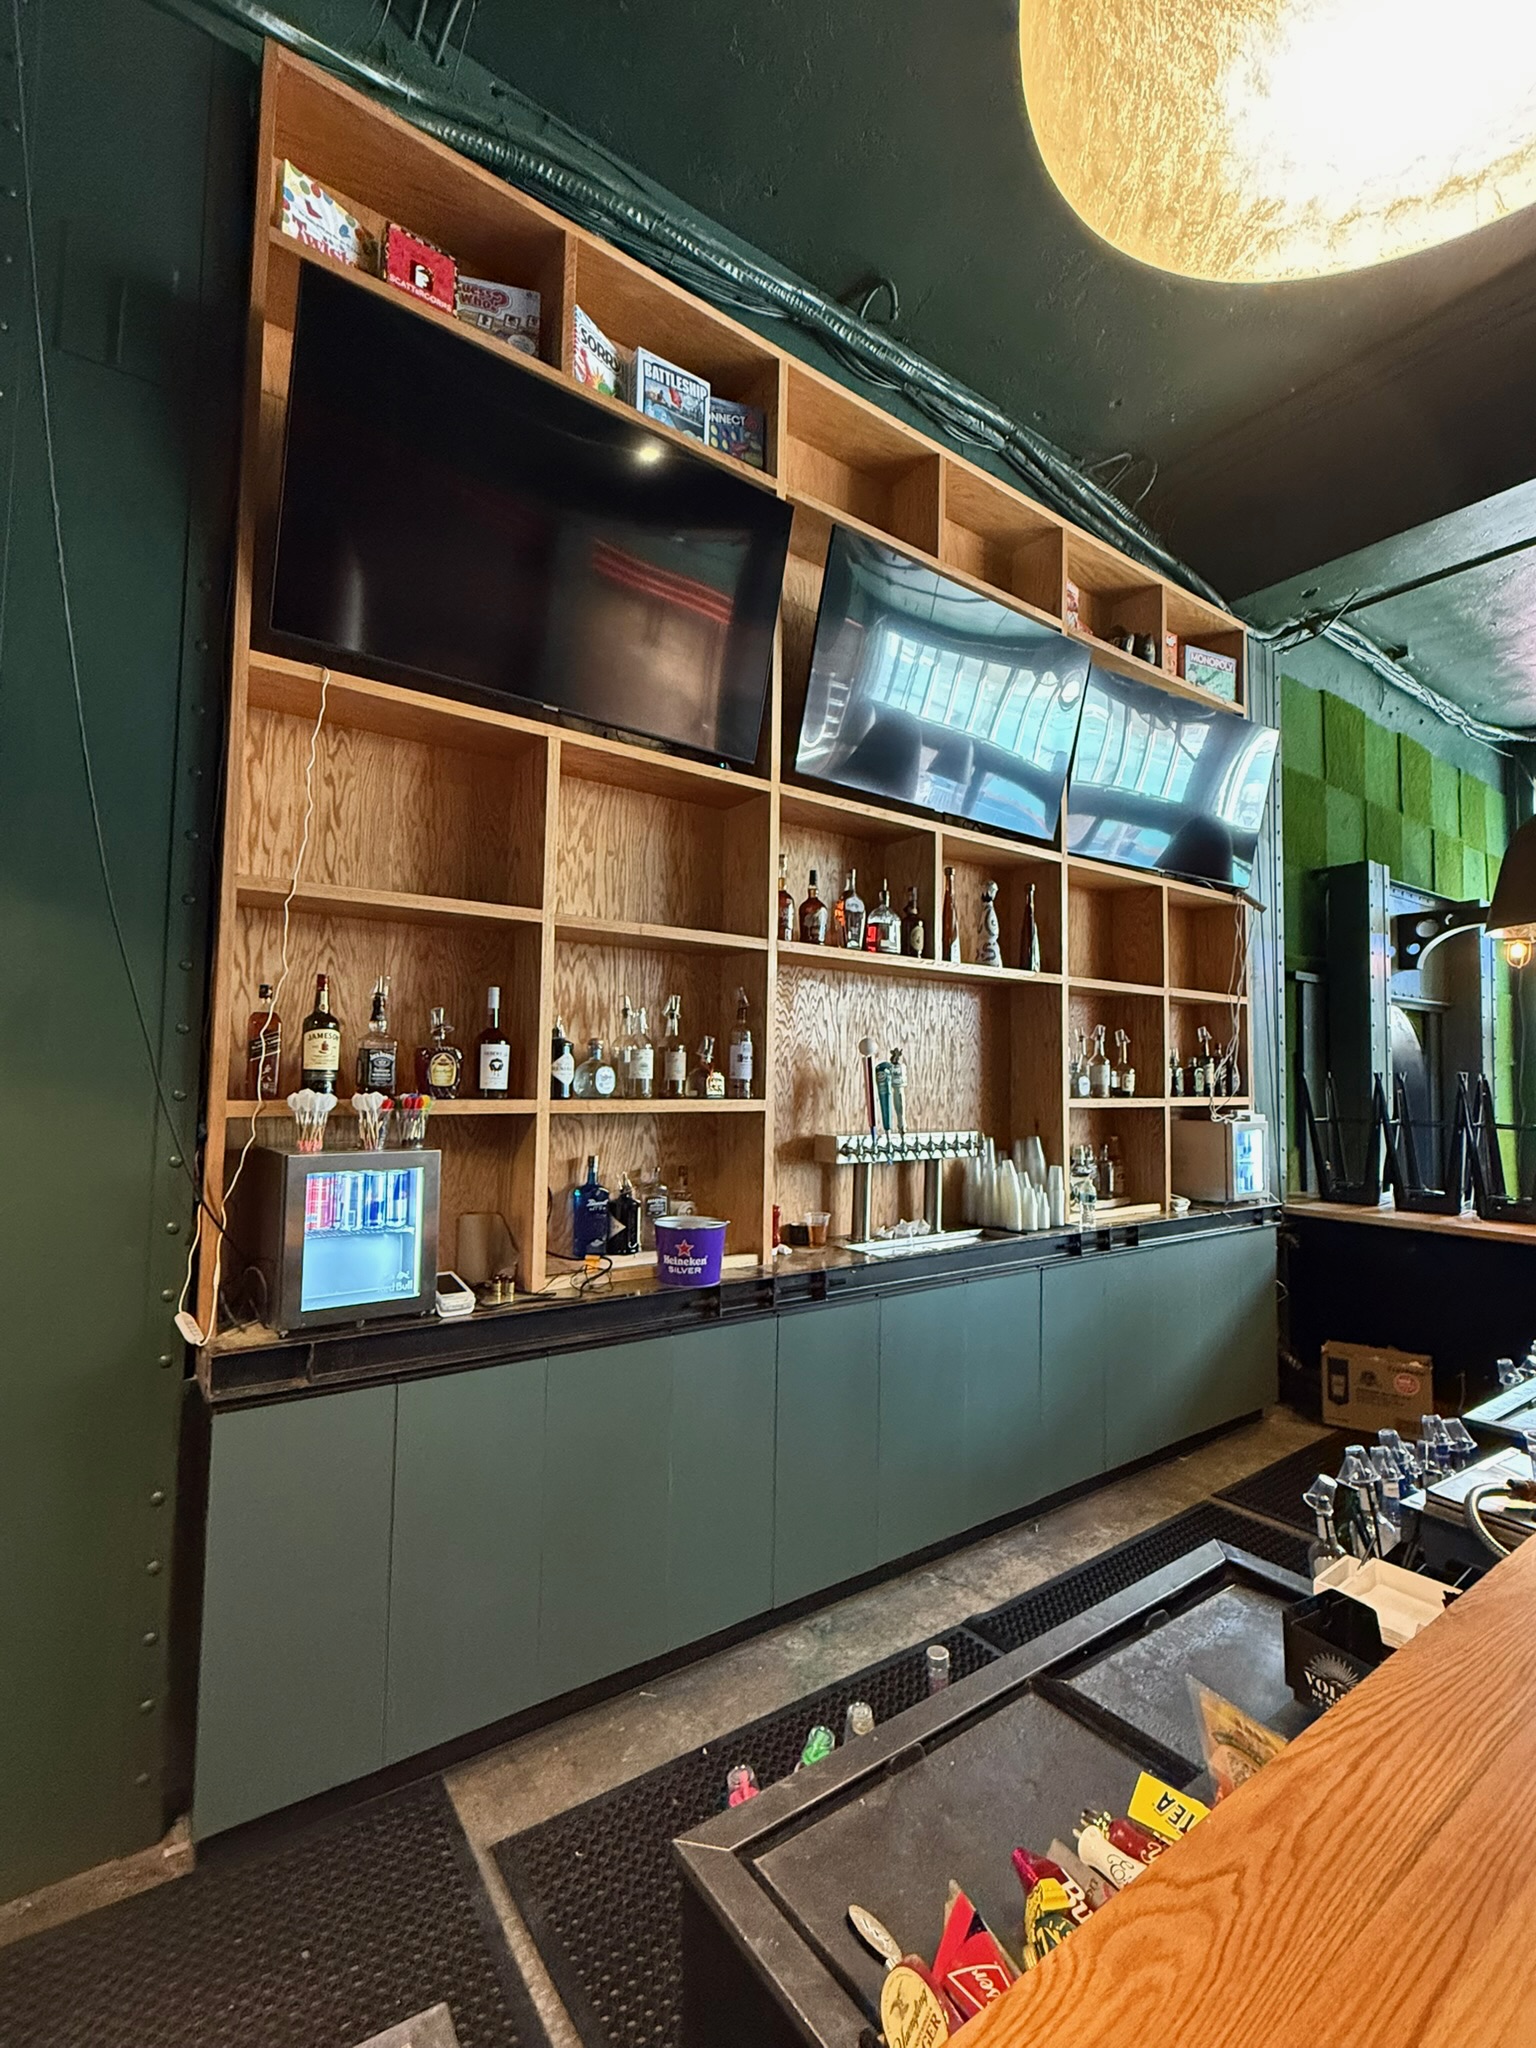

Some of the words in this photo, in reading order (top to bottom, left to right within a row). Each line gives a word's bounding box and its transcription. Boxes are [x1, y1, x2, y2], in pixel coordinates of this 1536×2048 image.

[644, 361, 708, 402] BATTLESHIP
[1190, 652, 1233, 673] MONOPOLY
[308, 1032, 339, 1041] JAMESON
[663, 1254, 707, 1267] Heineken
[668, 1265, 702, 1275] SILVER
[1156, 1791, 1196, 1834] TEA
